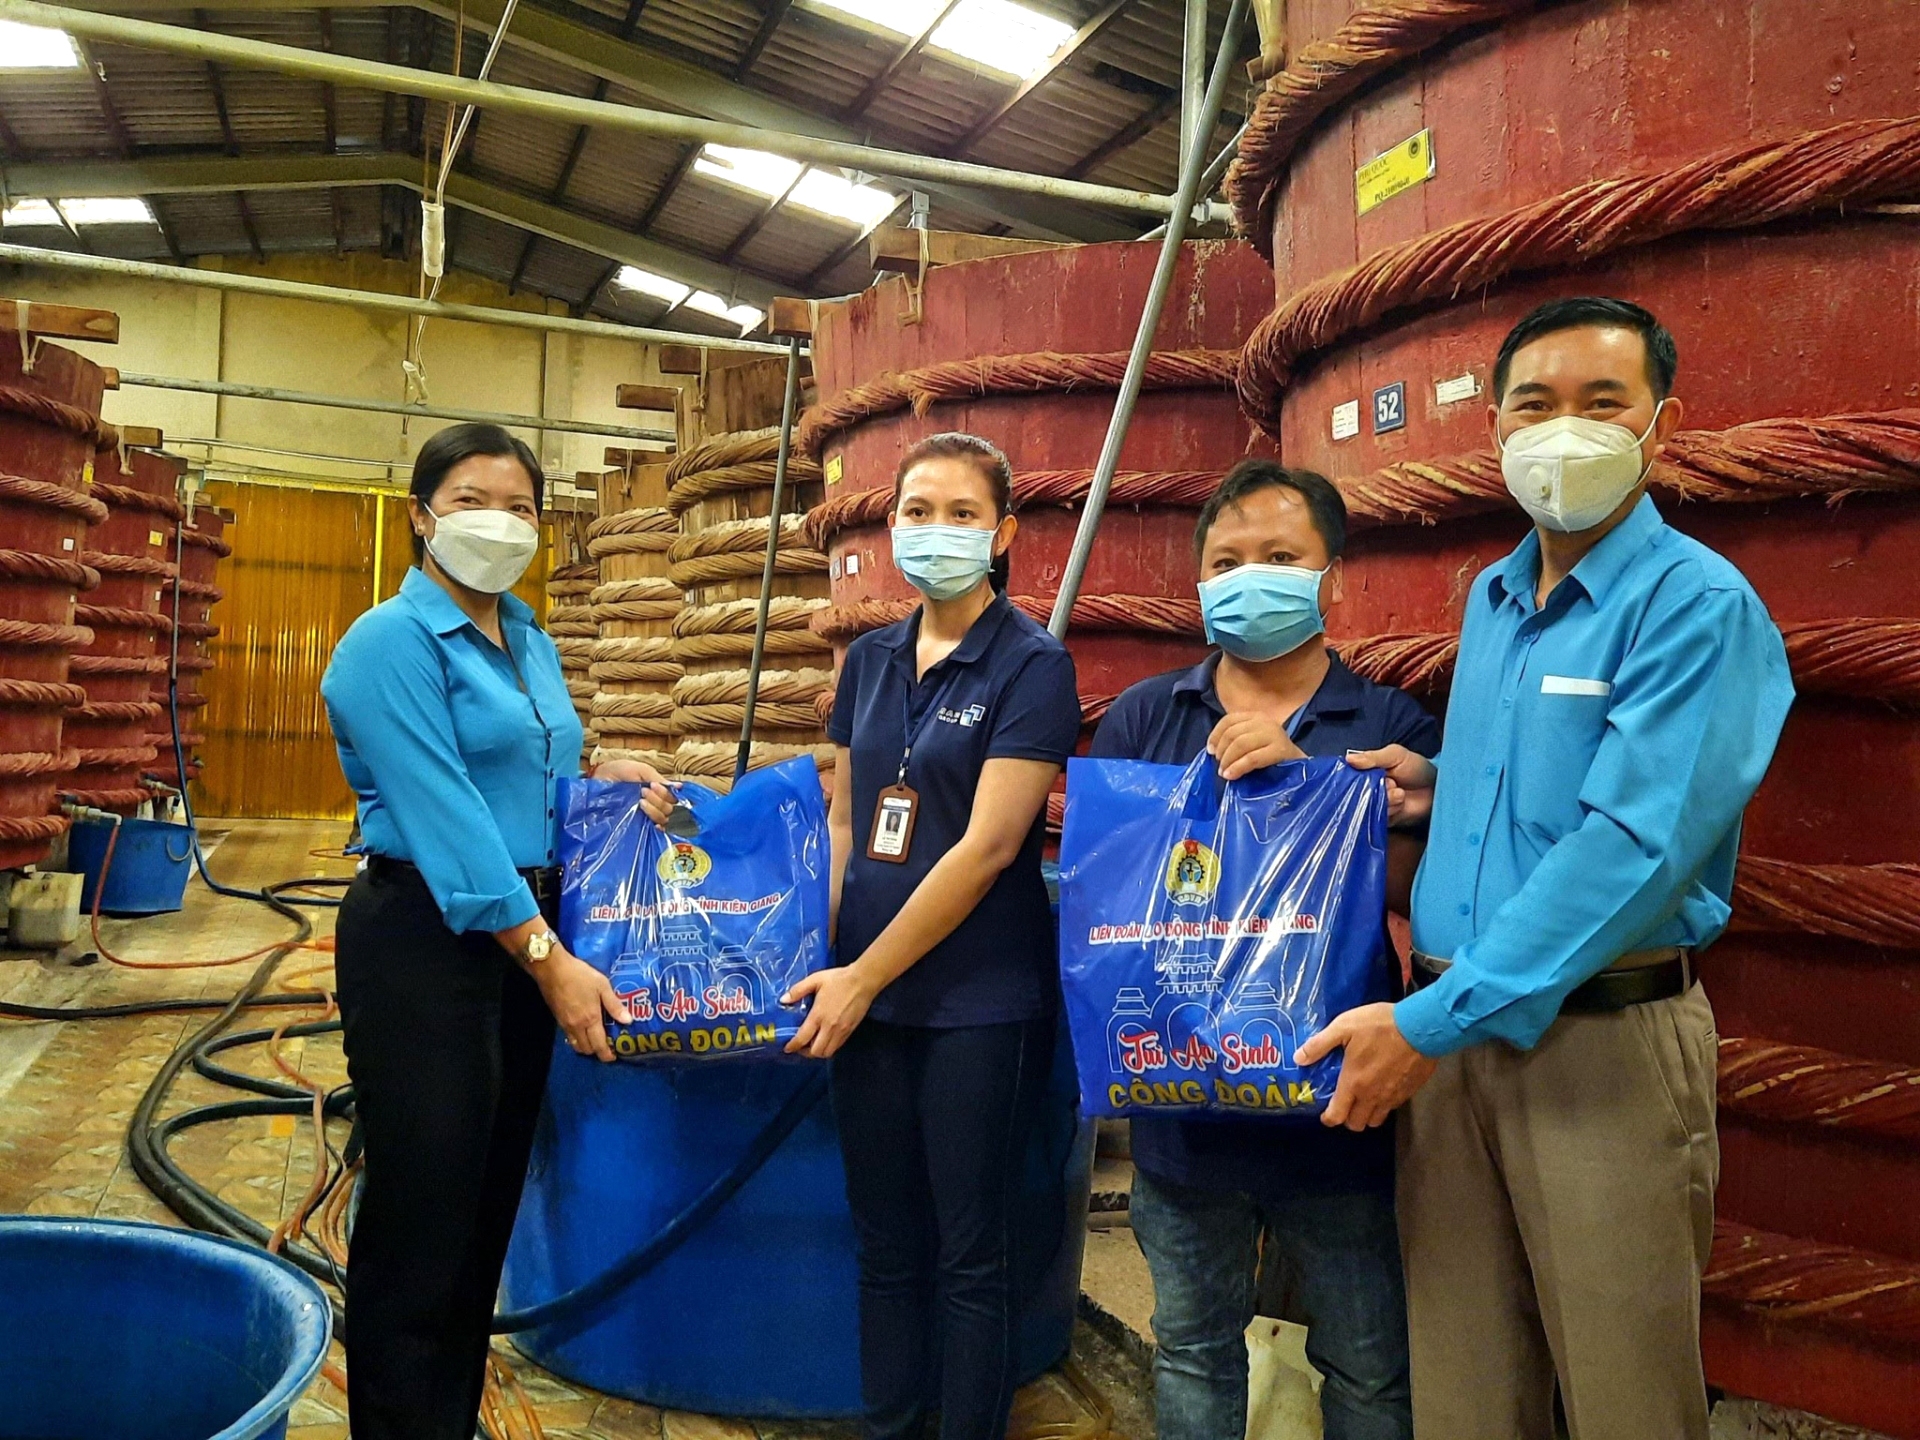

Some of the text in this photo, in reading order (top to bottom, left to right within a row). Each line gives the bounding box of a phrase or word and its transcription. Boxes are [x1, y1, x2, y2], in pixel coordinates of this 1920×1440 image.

[1378, 391, 1399, 423] 52
[592, 905, 616, 919] LIÊN
[721, 899, 748, 912] KIÊN
[750, 893, 780, 911] GIANG
[1090, 923, 1112, 941] LIÊN
[1114, 921, 1142, 940] ĐOÀN
[1165, 918, 1201, 941] ĐỘNG
[657, 987, 698, 1021] An
[702, 986, 750, 1018] Sinh
[690, 1019, 776, 1053] ĐOÀN
[1171, 1035, 1215, 1069] An
[1220, 1033, 1281, 1071] Sinh
[1108, 1074, 1315, 1108] CÔNG ĐOÀN
